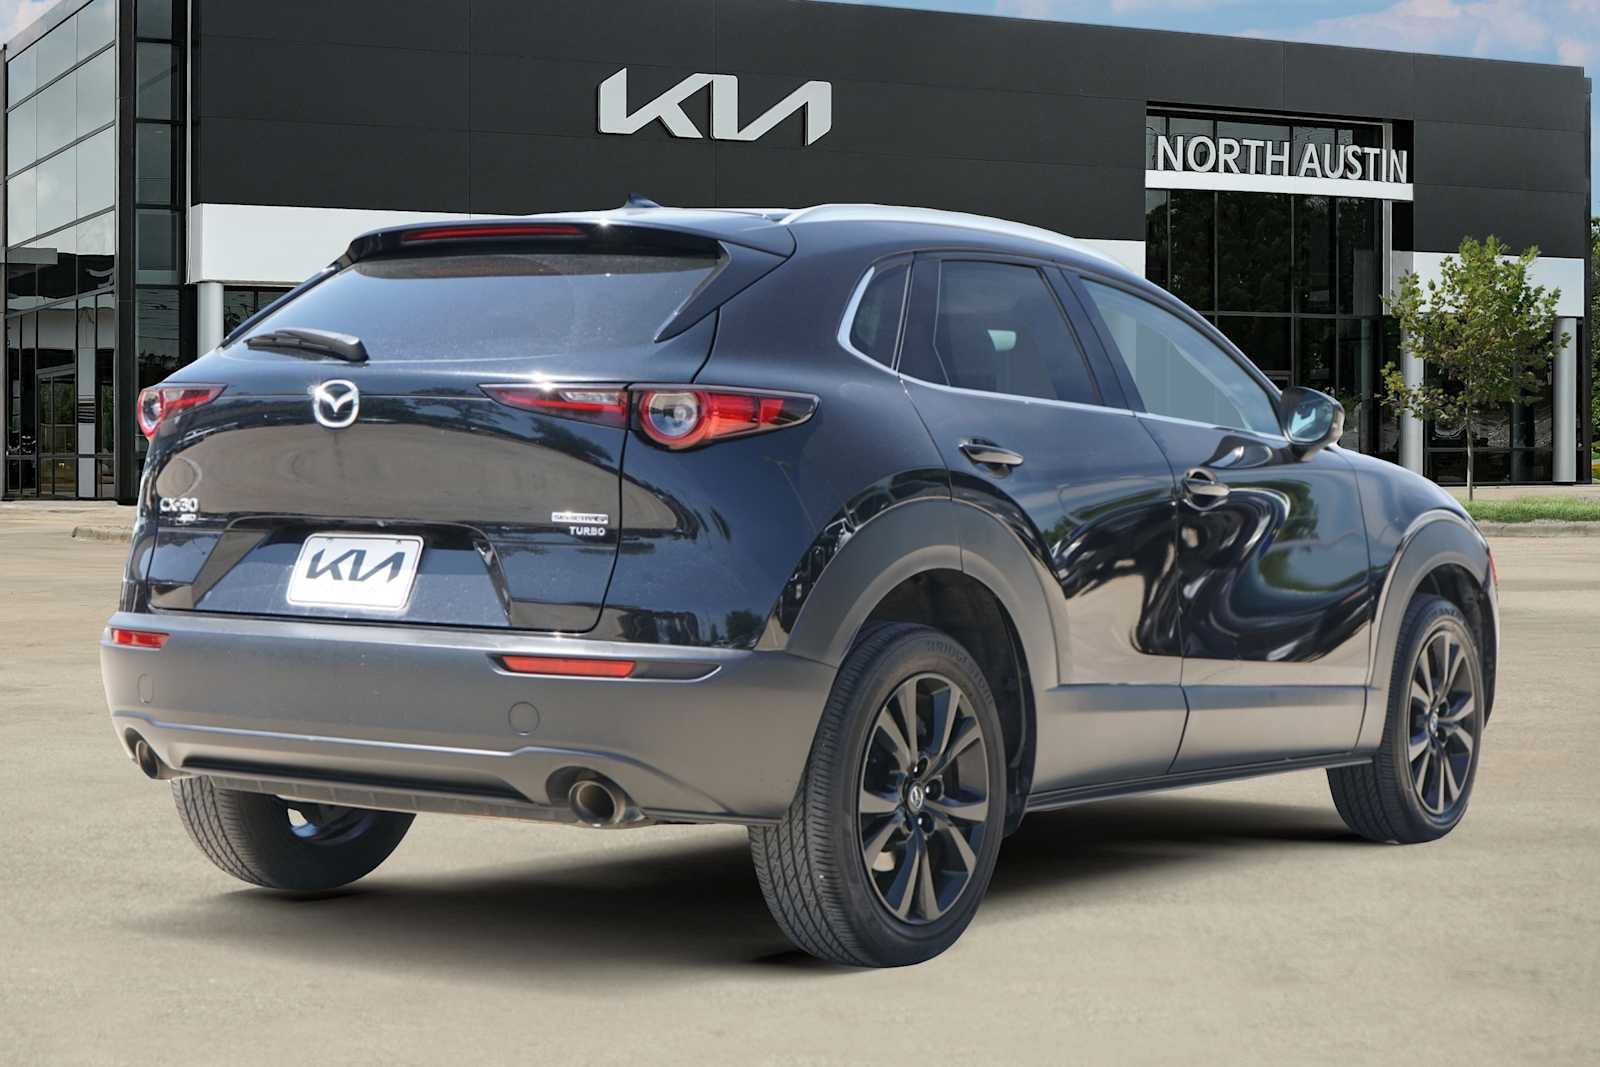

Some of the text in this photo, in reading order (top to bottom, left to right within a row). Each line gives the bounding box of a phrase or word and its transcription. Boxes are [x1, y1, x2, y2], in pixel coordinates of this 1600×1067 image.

[599, 67, 832, 146] KIA
[1157, 135, 1408, 184] NORTH AUSTIN
[160, 497, 198, 512] CX-30
[569, 526, 606, 537] TURBO
[306, 548, 406, 583] KIA
[926, 640, 993, 705] BRIDGESTON
